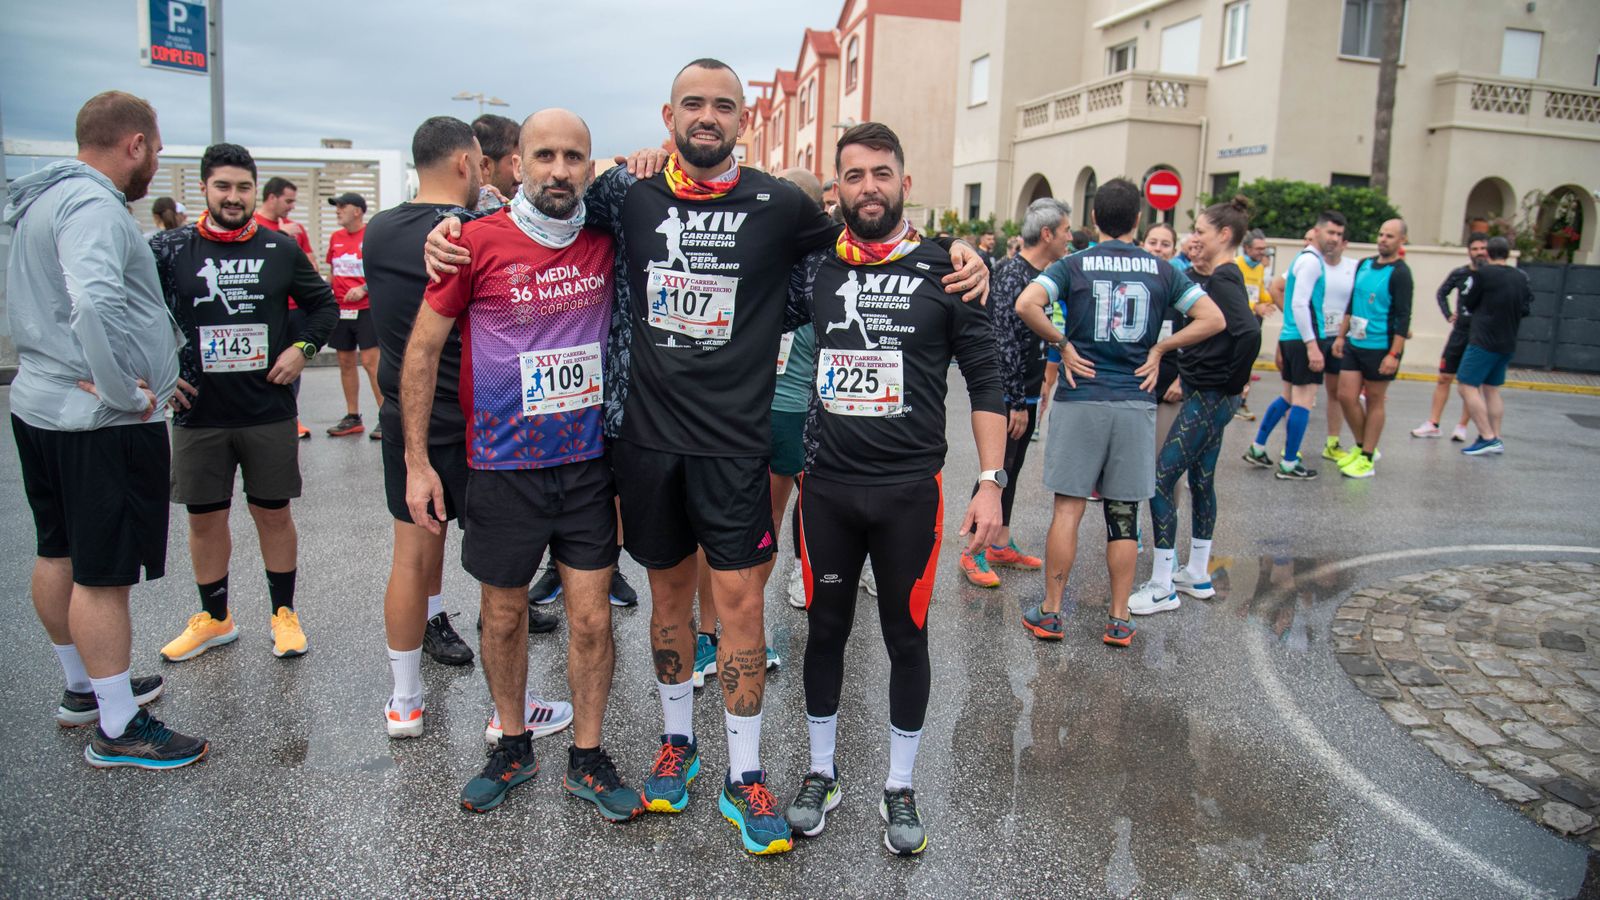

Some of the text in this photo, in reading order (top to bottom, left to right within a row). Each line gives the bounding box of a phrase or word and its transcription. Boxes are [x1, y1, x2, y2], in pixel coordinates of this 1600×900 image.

[168, 1, 188, 33] P
[151, 45, 205, 67] COMPLETO
[685, 210, 748, 232] XIV
[681, 240, 735, 248] ESTRECHO
[682, 232, 731, 241] CARRERA
[219, 259, 265, 274] XIV
[690, 262, 740, 270] SERRANO
[1082, 256, 1159, 275] MARADONA
[535, 264, 581, 285] MEDIA
[662, 274, 690, 290] XIV
[509, 272, 605, 303] 36 MARATÓN
[703, 286, 732, 294] ESTRECHO
[862, 273, 924, 295] XIV
[670, 289, 713, 317] 107
[858, 294, 906, 303] CARRERA
[858, 300, 910, 310] ESTRECHO
[1093, 280, 1151, 342] 10
[865, 317, 893, 325] PEPE
[866, 323, 916, 333] SERRANO
[212, 328, 233, 338] XIV
[879, 335, 888, 345] 8
[219, 337, 251, 355] 143
[535, 353, 562, 368] XIV
[562, 350, 586, 359] CARRERA
[574, 354, 598, 363] ESTRECHO
[831, 354, 854, 367] XIV
[544, 363, 584, 391] 109
[835, 367, 879, 394] 225
